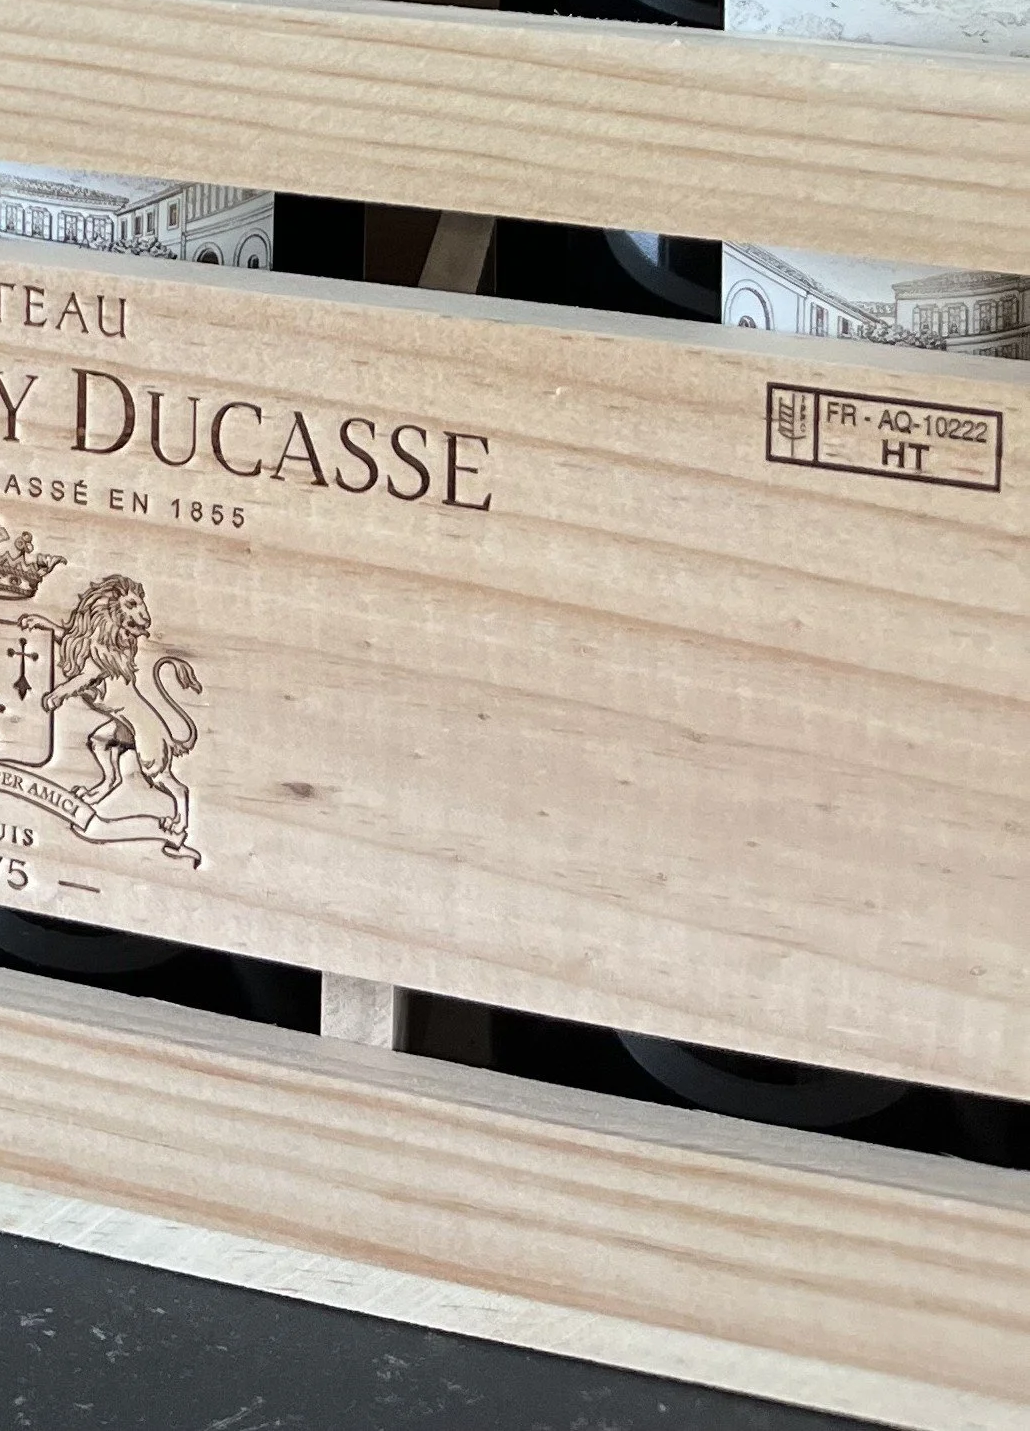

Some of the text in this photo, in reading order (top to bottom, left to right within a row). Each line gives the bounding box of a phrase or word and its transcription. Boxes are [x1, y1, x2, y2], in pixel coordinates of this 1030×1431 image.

[70, 367, 494, 512] DUCASSE
[881, 438, 931, 472] HT
[109, 488, 151, 515] EN
[169, 498, 247, 529] 1855
[27, 782, 80, 818] AMICI
